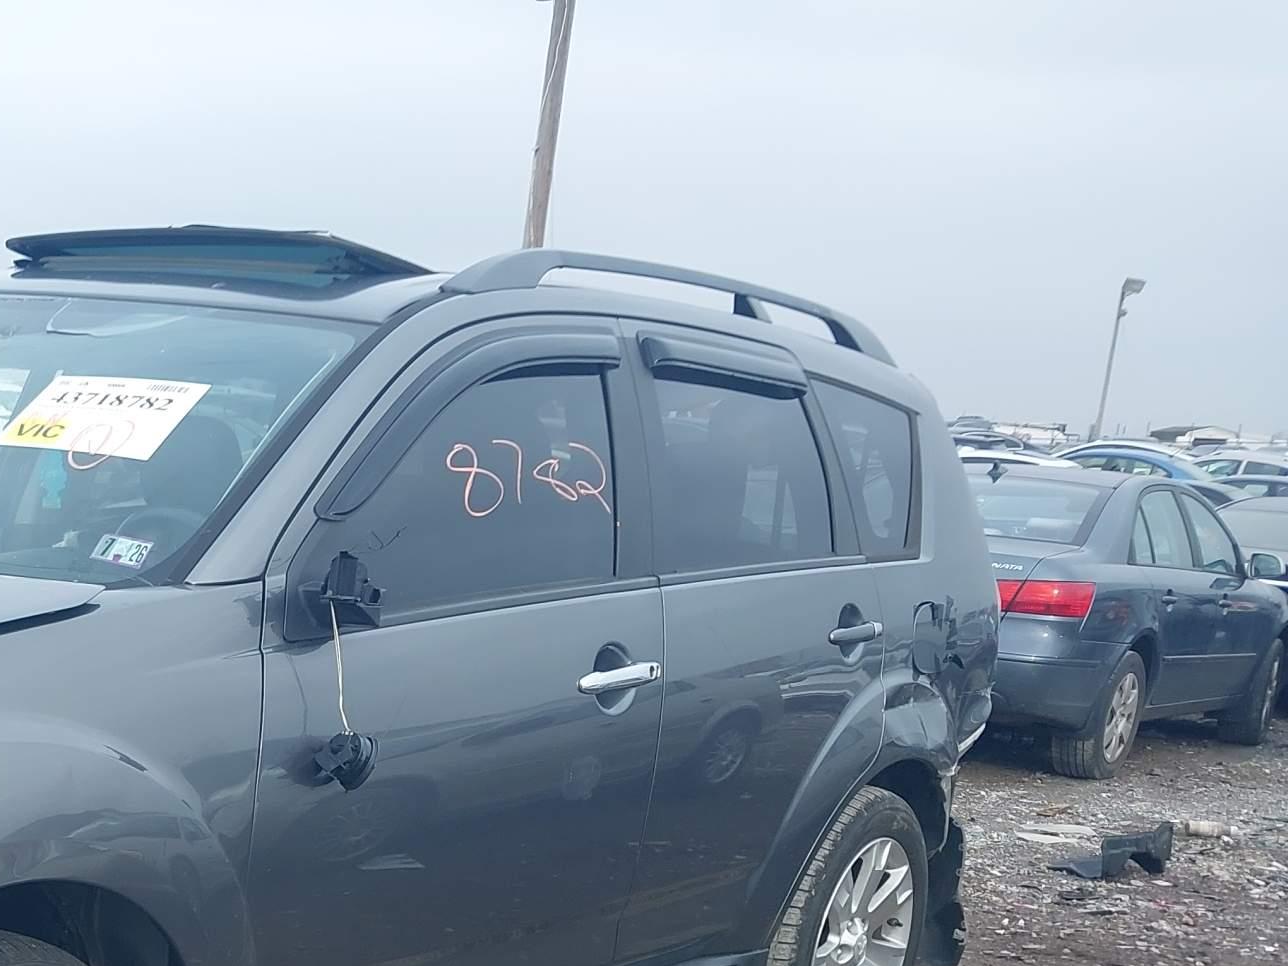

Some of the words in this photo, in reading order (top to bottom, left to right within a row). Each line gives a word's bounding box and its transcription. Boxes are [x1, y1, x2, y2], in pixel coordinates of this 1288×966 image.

[52, 391, 173, 410] 43718782
[17, 423, 65, 439] VIC
[446, 439, 611, 517] 8782
[128, 543, 148, 563] 26
